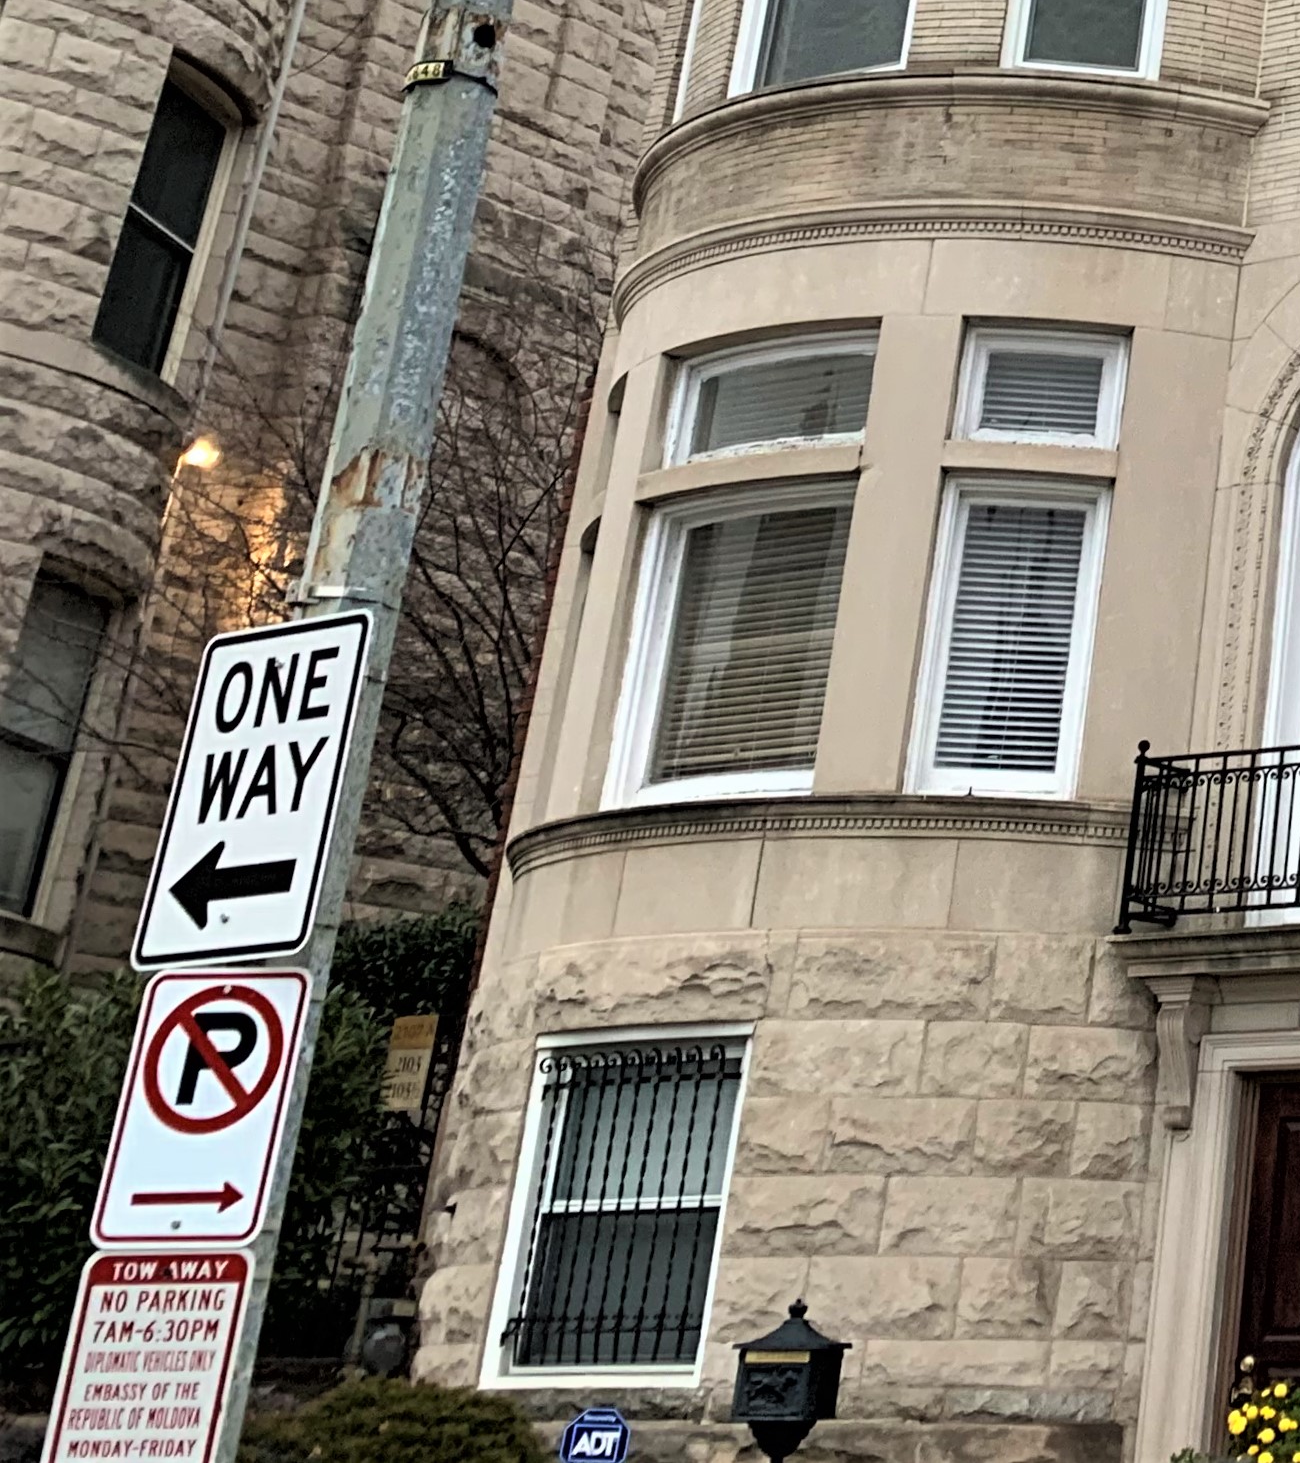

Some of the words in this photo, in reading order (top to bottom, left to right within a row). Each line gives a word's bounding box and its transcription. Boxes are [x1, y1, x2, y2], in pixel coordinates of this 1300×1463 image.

[215, 646, 340, 734] ONE
[197, 736, 330, 825] WAY
[112, 1261, 159, 1281] TOW
[163, 1260, 229, 1280] AWAY
[99, 1291, 128, 1313] NO
[135, 1289, 226, 1313] PARKING
[92, 1319, 220, 1343] 7AM-6:30PM
[84, 1351, 142, 1373] DIPLOMATIC
[142, 1350, 188, 1373] VEHICLES
[189, 1349, 217, 1372] ONLY
[84, 1383, 148, 1402] EMBASSY
[151, 1382, 171, 1401] OF
[174, 1381, 201, 1400] THE
[67, 1408, 125, 1430] REPUBLIC
[127, 1407, 146, 1430] OF
[145, 1406, 201, 1430] MOLDOVA
[66, 1439, 198, 1459] MONDAY-FRIDAY
[571, 1430, 621, 1457] ADT
